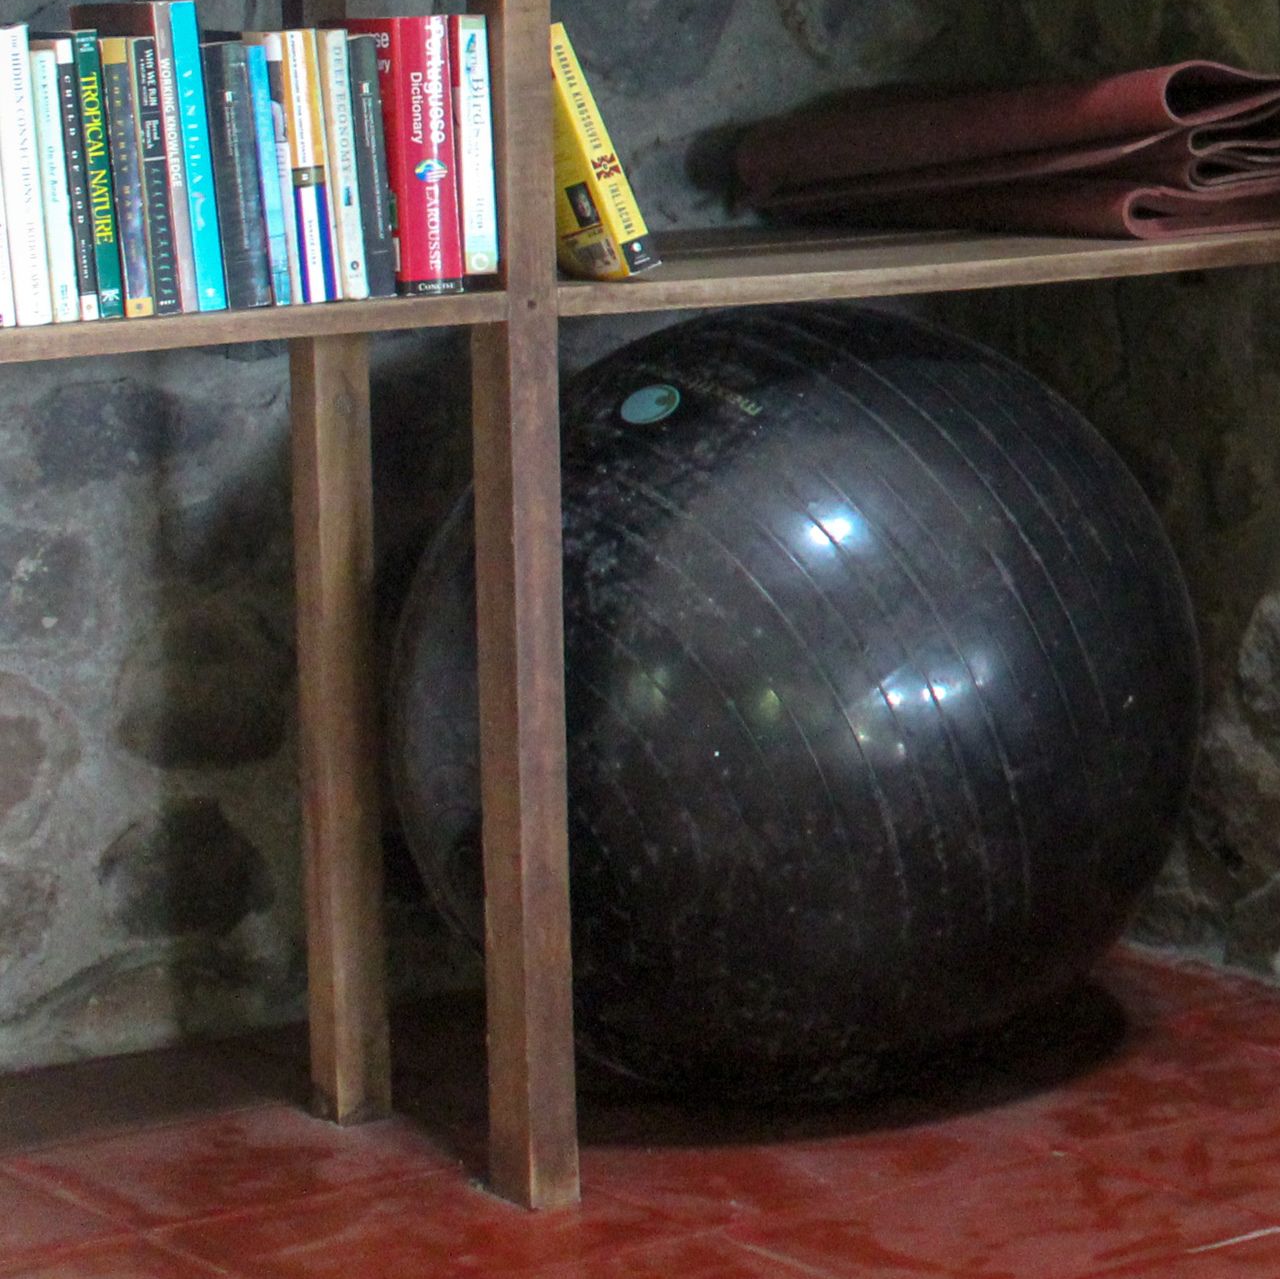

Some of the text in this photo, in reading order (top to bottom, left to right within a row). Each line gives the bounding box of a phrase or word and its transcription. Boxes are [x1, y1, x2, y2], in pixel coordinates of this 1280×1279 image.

[159, 56, 183, 189] WORKING KNOWLEDGE
[181, 68, 204, 185] VANILLA
[409, 23, 446, 145] Portuguese Dictionary
[79, 71, 114, 245] TROPICAL NATURE
[425, 182, 443, 272] LAROUSSE
